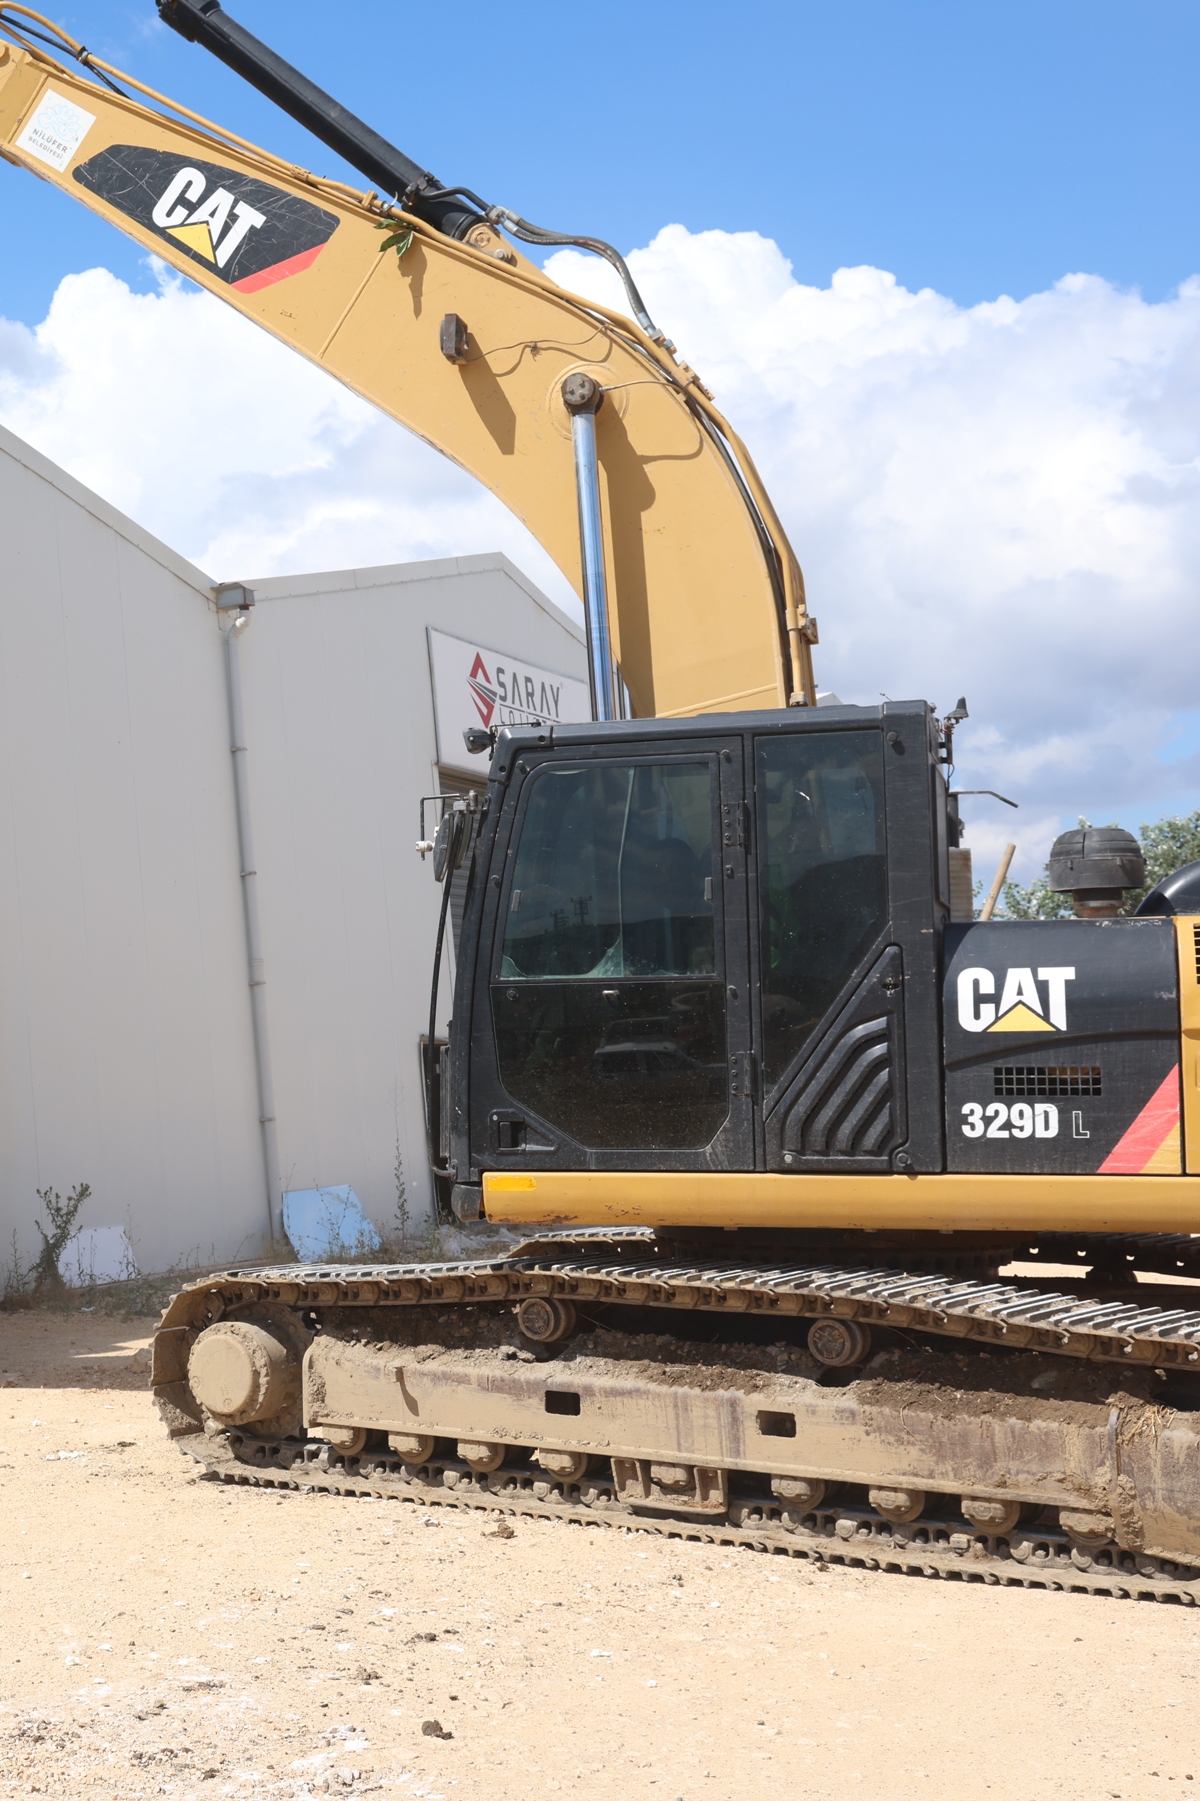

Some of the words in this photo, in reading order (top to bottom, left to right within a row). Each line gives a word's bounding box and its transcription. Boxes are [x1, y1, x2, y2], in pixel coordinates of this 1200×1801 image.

[152, 167, 266, 268] CAT
[496, 666, 560, 718] SARAY
[957, 966, 1075, 1033] CAT
[961, 1102, 1059, 1138] 329D
[1072, 1111, 1090, 1138] L
